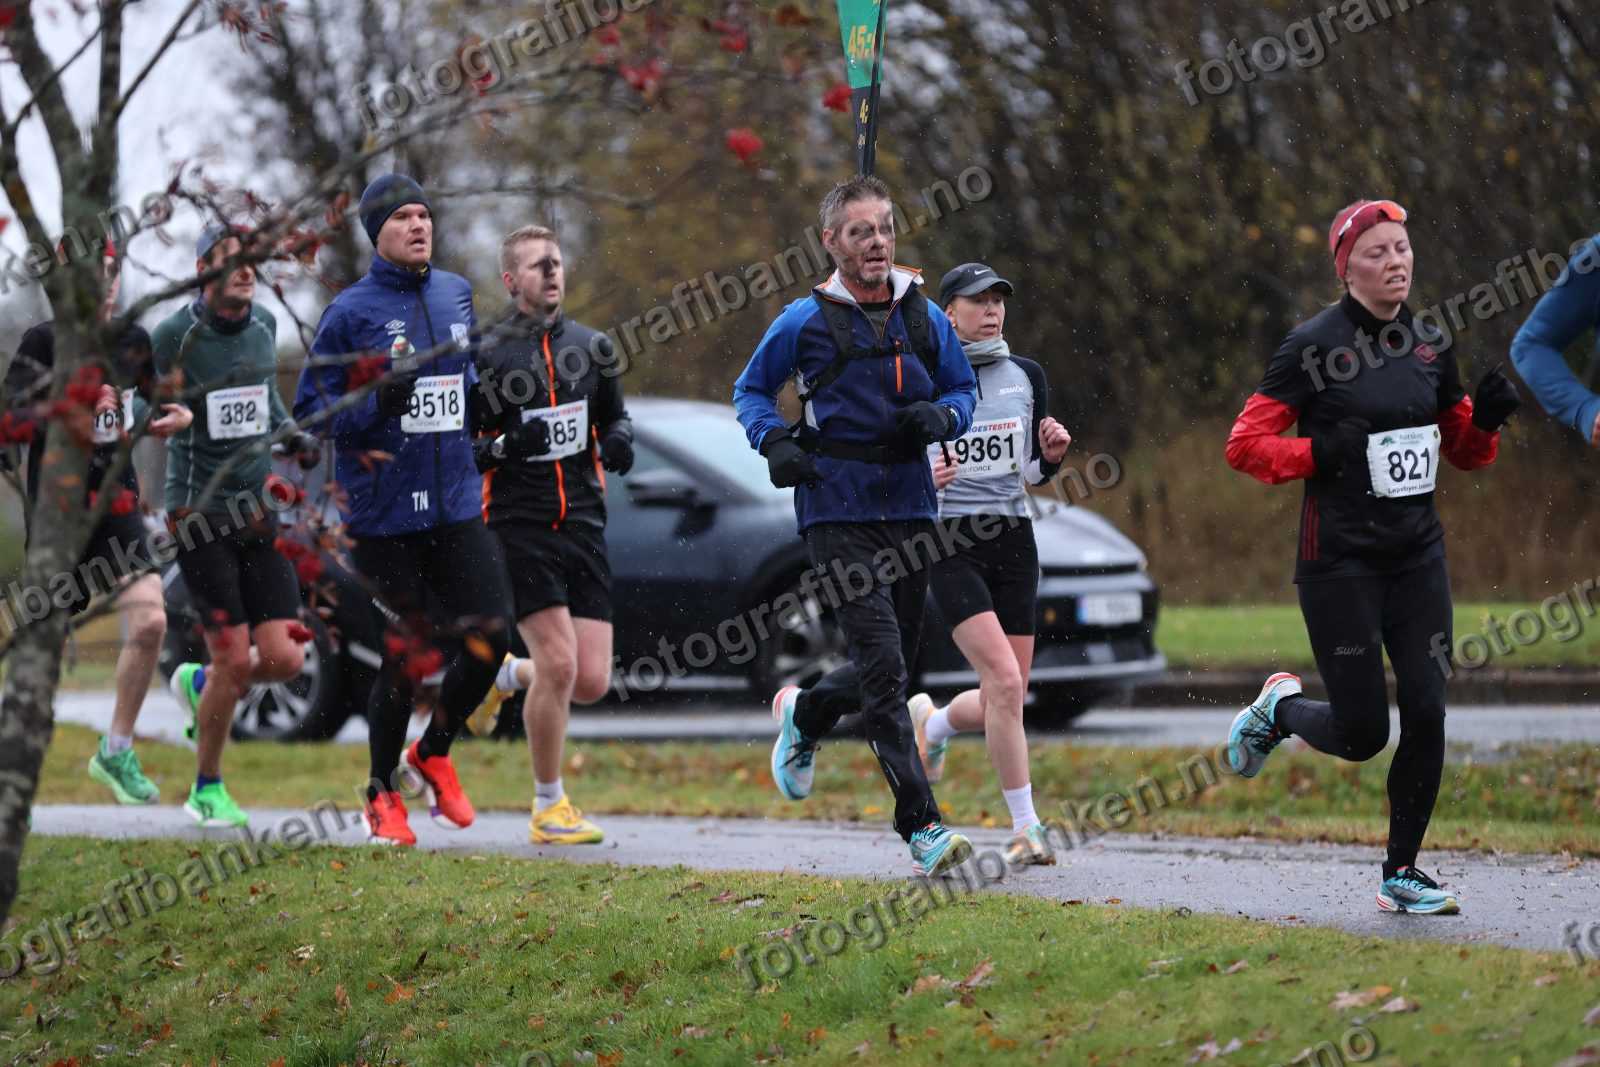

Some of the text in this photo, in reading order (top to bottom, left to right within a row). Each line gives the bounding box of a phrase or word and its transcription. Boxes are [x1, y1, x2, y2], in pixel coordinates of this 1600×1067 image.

[220, 400, 256, 425] 382
[408, 389, 459, 418] 9518
[954, 433, 1014, 464] 9361
[1388, 447, 1430, 483] 821
[411, 490, 429, 512] TN
